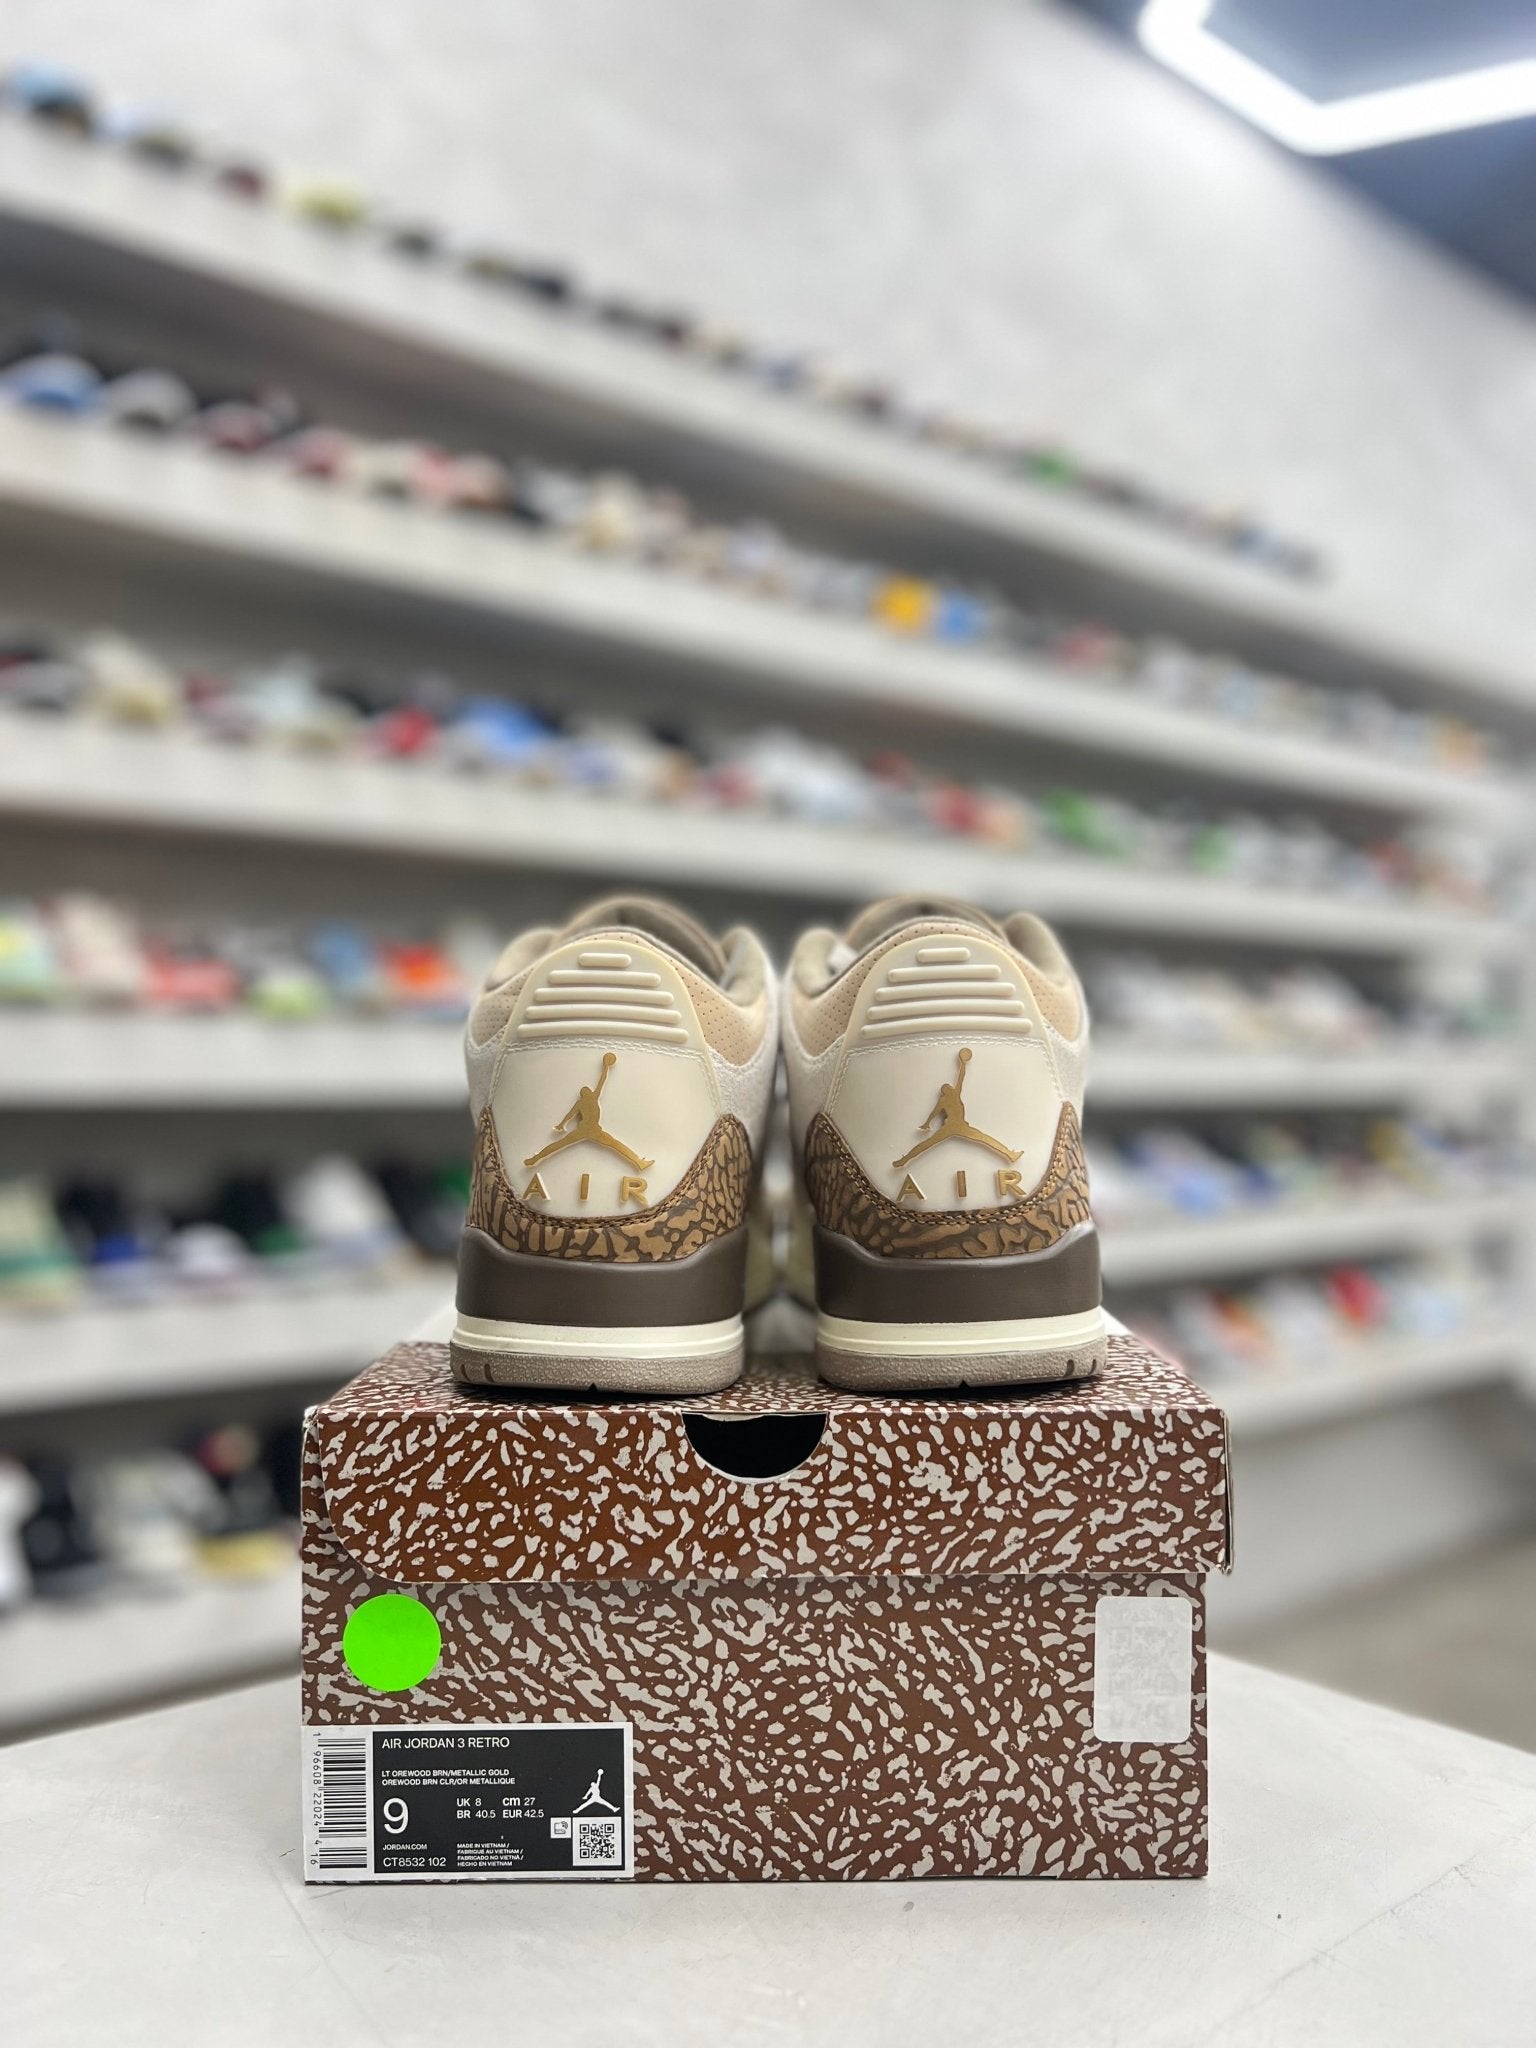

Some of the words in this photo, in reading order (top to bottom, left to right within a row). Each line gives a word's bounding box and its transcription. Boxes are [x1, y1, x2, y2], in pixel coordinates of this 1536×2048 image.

[522, 1172, 649, 1206] AIR
[892, 1169, 1027, 1202] AIR
[381, 1738, 402, 1749] AIR
[404, 1737, 455, 1749] JORDAN
[457, 1737, 466, 1748] 3
[468, 1736, 510, 1748] RETRO
[312, 1750, 322, 1785] 96608
[381, 1770, 391, 1778] LT
[391, 1769, 432, 1778] OREWOOD
[432, 1769, 487, 1778] BRN/METALLIC
[488, 1769, 510, 1777] GOLD
[381, 1778, 421, 1786] OREWOOD
[422, 1778, 438, 1786] BRN
[439, 1778, 468, 1786] CLR/OR
[469, 1777, 516, 1785] METALLIQUE
[456, 1798, 471, 1807] UK
[475, 1798, 482, 1807] 8
[502, 1797, 521, 1807] cm
[523, 1797, 536, 1806] 27
[313, 1792, 323, 1826] 22024
[456, 1810, 471, 1819] BR
[475, 1809, 496, 1819] 40.5
[502, 1809, 523, 1819] EUR
[523, 1809, 545, 1818] 42.5
[383, 1797, 409, 1834] 9
[382, 1843, 428, 1851] JORDAN.COM
[382, 1856, 426, 1867] CT8532
[428, 1856, 447, 1867] 102
